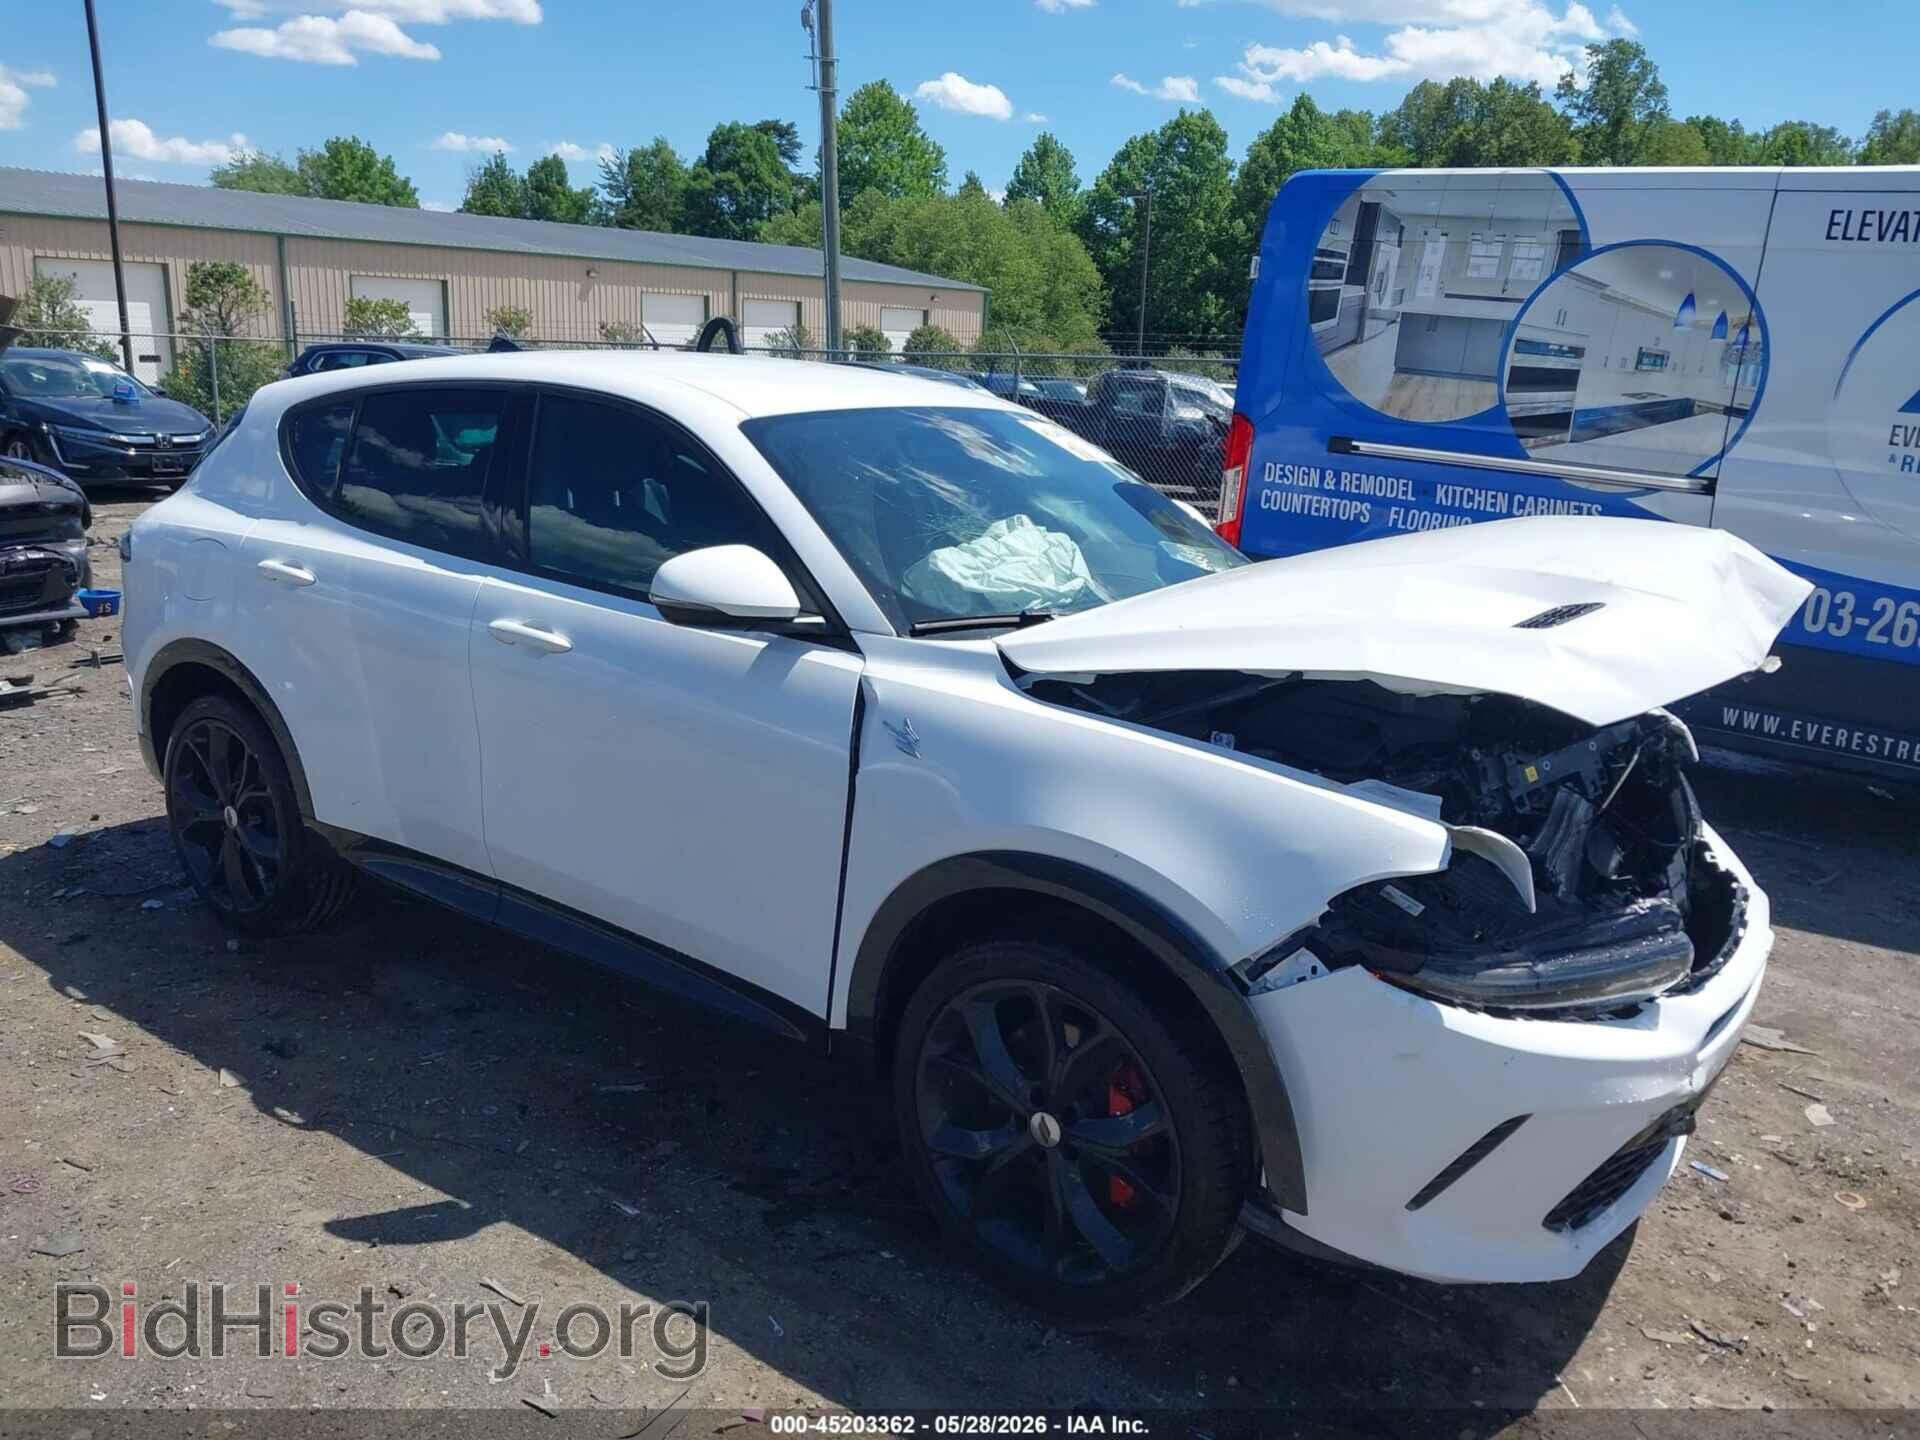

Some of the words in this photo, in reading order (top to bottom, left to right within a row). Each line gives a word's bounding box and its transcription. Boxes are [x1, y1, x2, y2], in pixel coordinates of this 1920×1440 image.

[1260, 489, 1372, 524] COUNTERTOPS
[1264, 462, 1320, 488] DESIGN
[1323, 470, 1336, 490] &
[1340, 471, 1416, 501] REMODEL
[1435, 483, 1508, 514] KITCHEN
